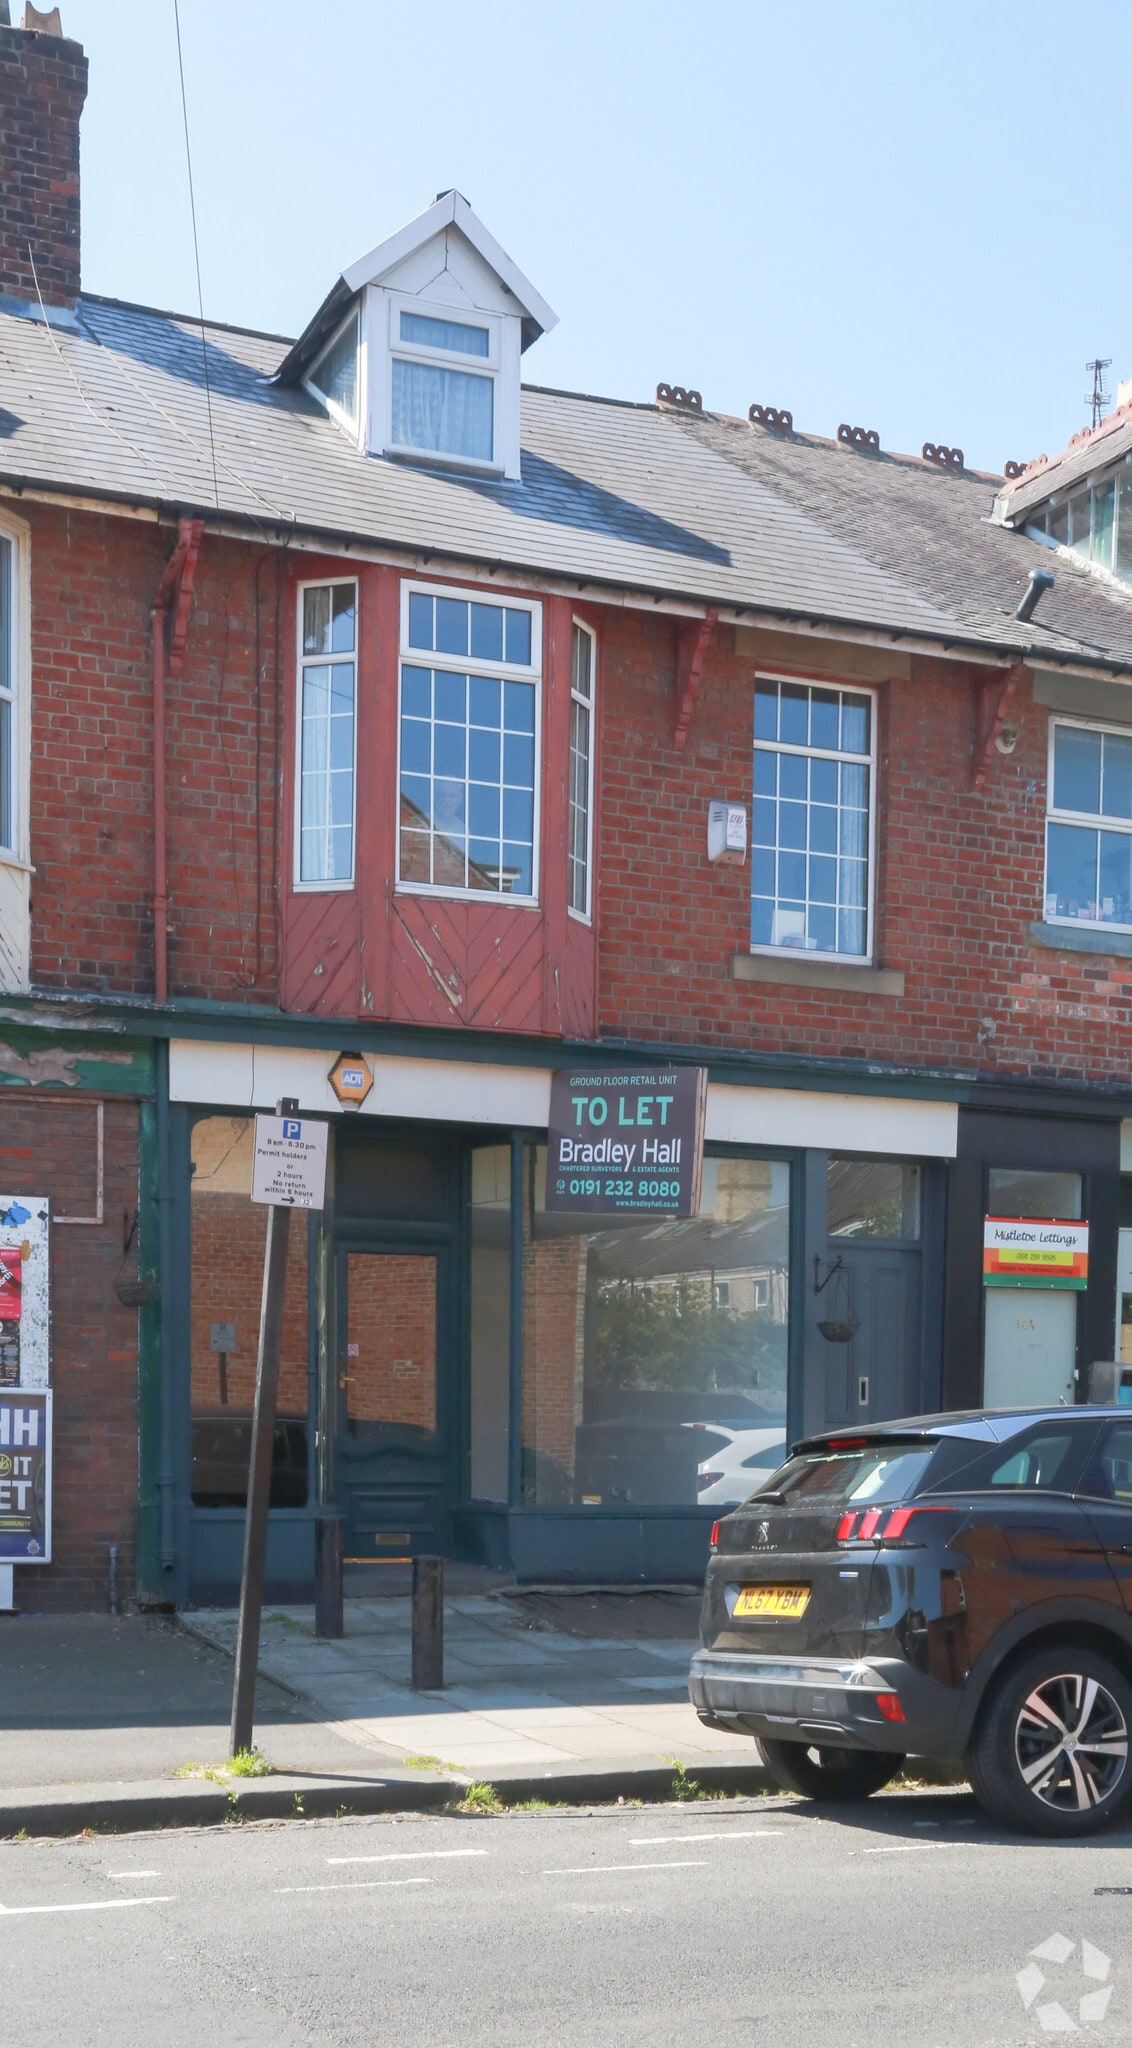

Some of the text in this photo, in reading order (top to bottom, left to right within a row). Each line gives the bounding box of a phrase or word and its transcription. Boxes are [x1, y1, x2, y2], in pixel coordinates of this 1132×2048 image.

[343, 1073, 363, 1085] ADT
[570, 1075, 678, 1086] GROUND FLOOR RETAIL UNIT
[572, 1096, 674, 1126] TO LET
[287, 1122, 299, 1137] P
[258, 1148, 307, 1160] Permit holders
[559, 1138, 682, 1172] Bradley Hall
[285, 1181, 306, 1189] return
[570, 1180, 680, 1197] 0191 232 8080
[616, 1200, 679, 1208] www.bradleyhall.co.uk
[994, 1229, 1078, 1247] Mistletoe Lettings
[13, 1456, 32, 1476] IT
[741, 1590, 803, 1610] NL67 YBM
